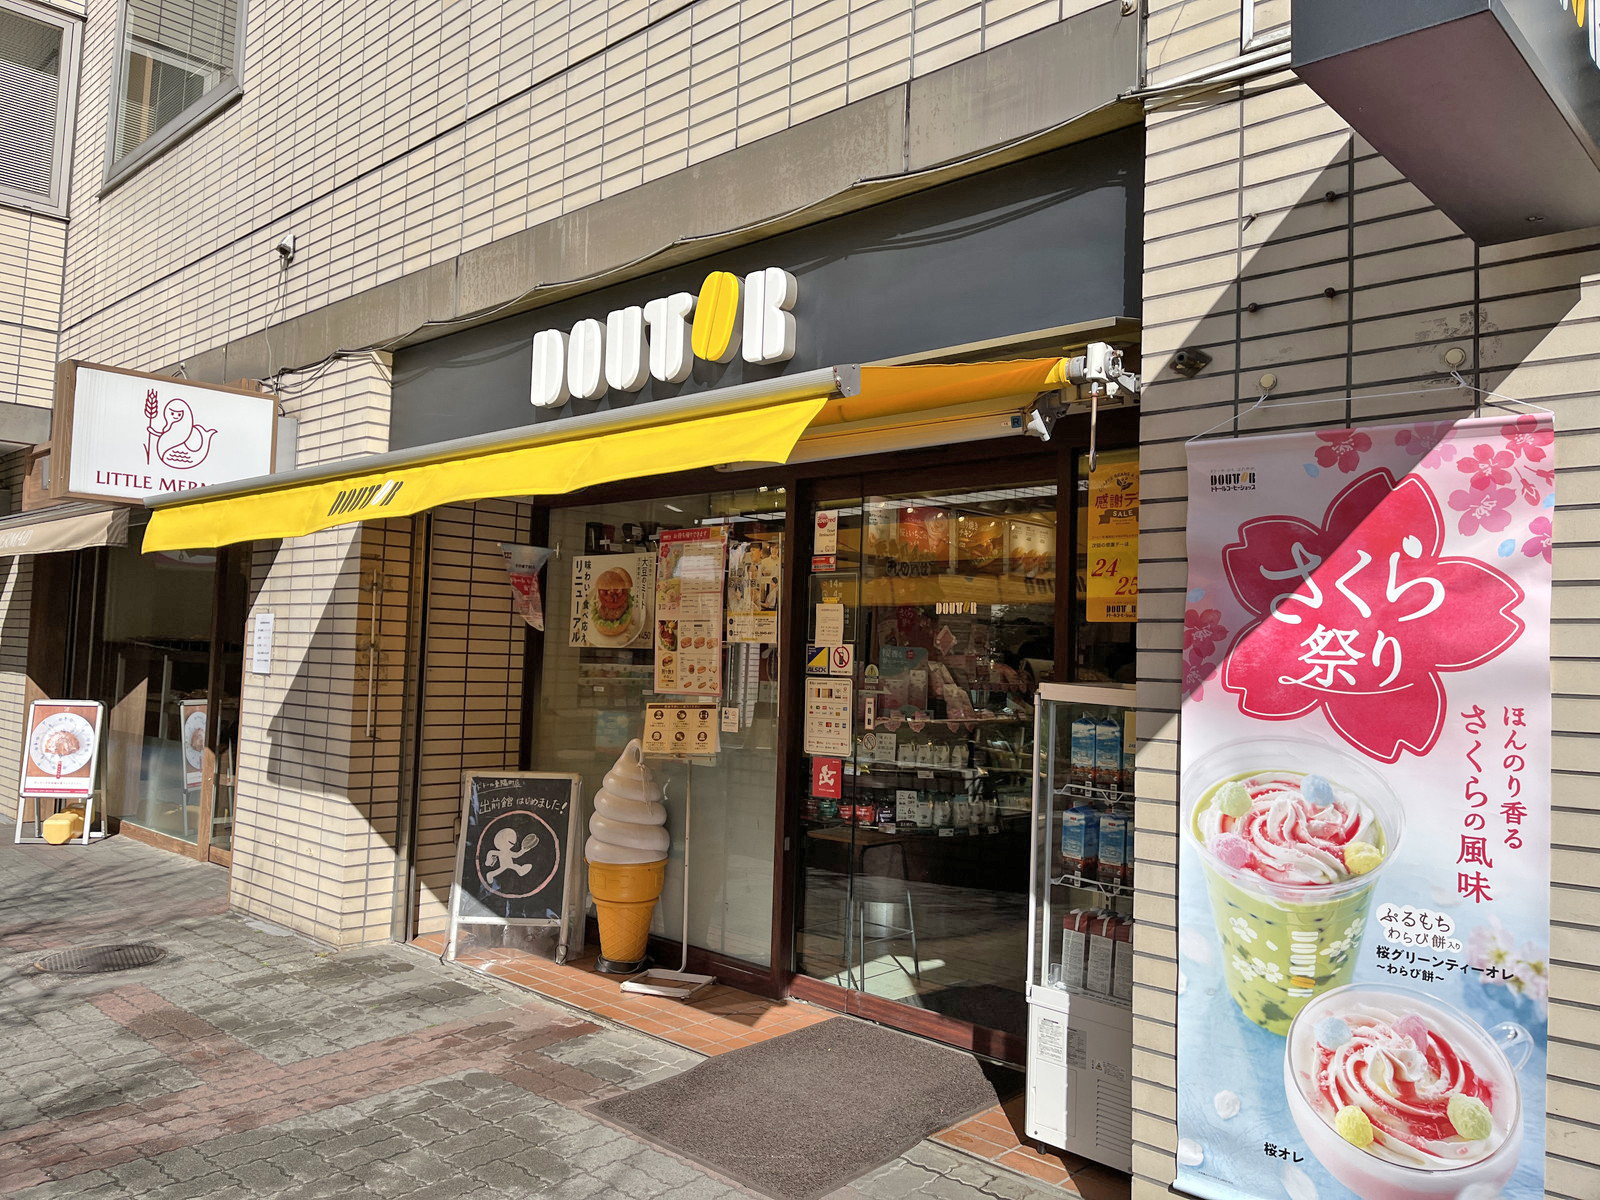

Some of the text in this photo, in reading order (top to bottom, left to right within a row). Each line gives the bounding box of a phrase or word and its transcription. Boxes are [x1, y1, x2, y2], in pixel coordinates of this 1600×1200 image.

[530, 267, 797, 408] DOUTOR
[96, 470, 215, 492] LITTLE MER
[1210, 472, 1256, 486] DOUTOR
[327, 479, 404, 517] DOUTOR
[1112, 509, 1134, 518] SALE
[1091, 558, 1118, 577] 24
[1259, 535, 1445, 624] さくら
[1115, 576, 1138, 596] 25
[571, 560, 583, 643] リニューアル
[581, 560, 592, 643] 味わい・食べ応え
[935, 602, 978, 615] DOUTOR
[1298, 623, 1403, 688] 祭り
[1500, 705, 1527, 850] ほんのり香る
[479, 797, 568, 814] 出前館 はじめました!
[1456, 704, 1493, 904] さくらの風味
[1380, 907, 1450, 933] ぷるもち
[1387, 926, 1461, 950] わらび餅入り
[1287, 931, 1319, 997] DOUTOR
[1376, 945, 1515, 980] 桜グリーンティーオレ
[1263, 1141, 1304, 1163] 桜オレ
